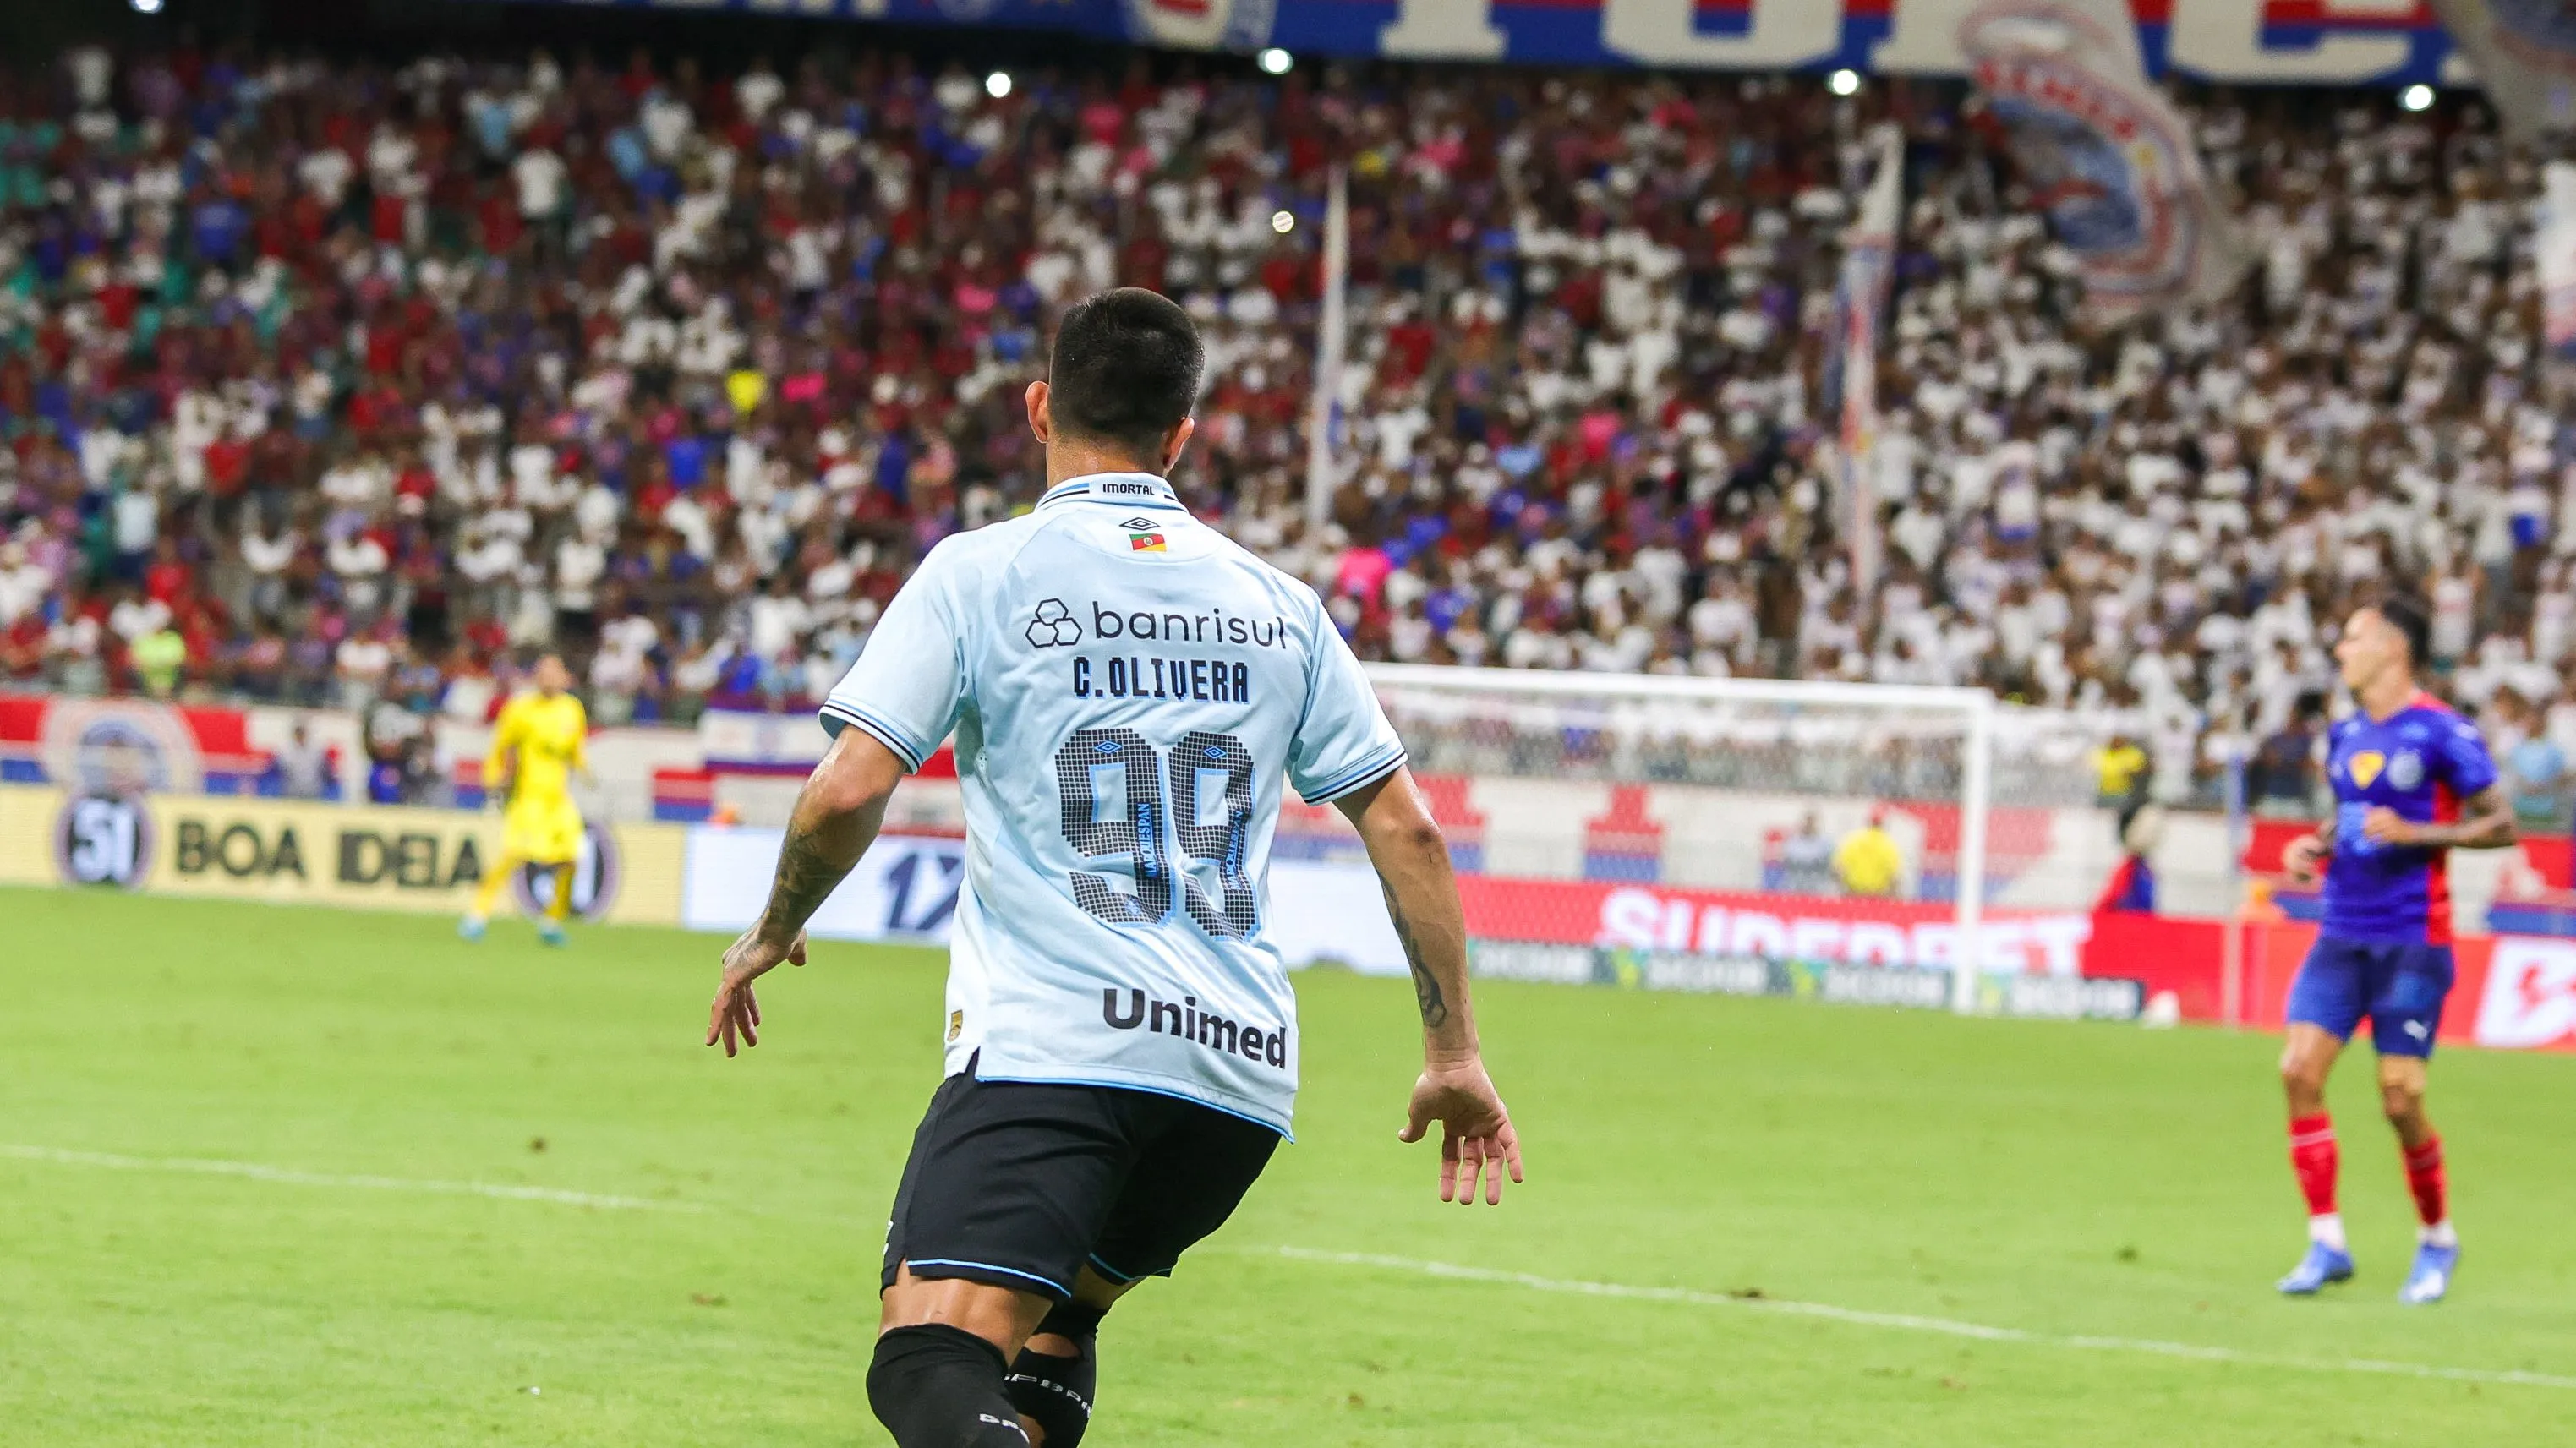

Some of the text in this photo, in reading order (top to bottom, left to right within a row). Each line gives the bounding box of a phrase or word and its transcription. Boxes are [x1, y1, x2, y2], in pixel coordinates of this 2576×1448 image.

[1102, 483, 1155, 495] IMORTAL
[1092, 600, 1287, 649] banrisul
[1074, 656, 1250, 704] C.OLIVERA
[72, 798, 135, 882] 51
[178, 821, 306, 876] BOA
[1054, 728, 1262, 943] 99
[1102, 988, 1287, 1069] Unimed
